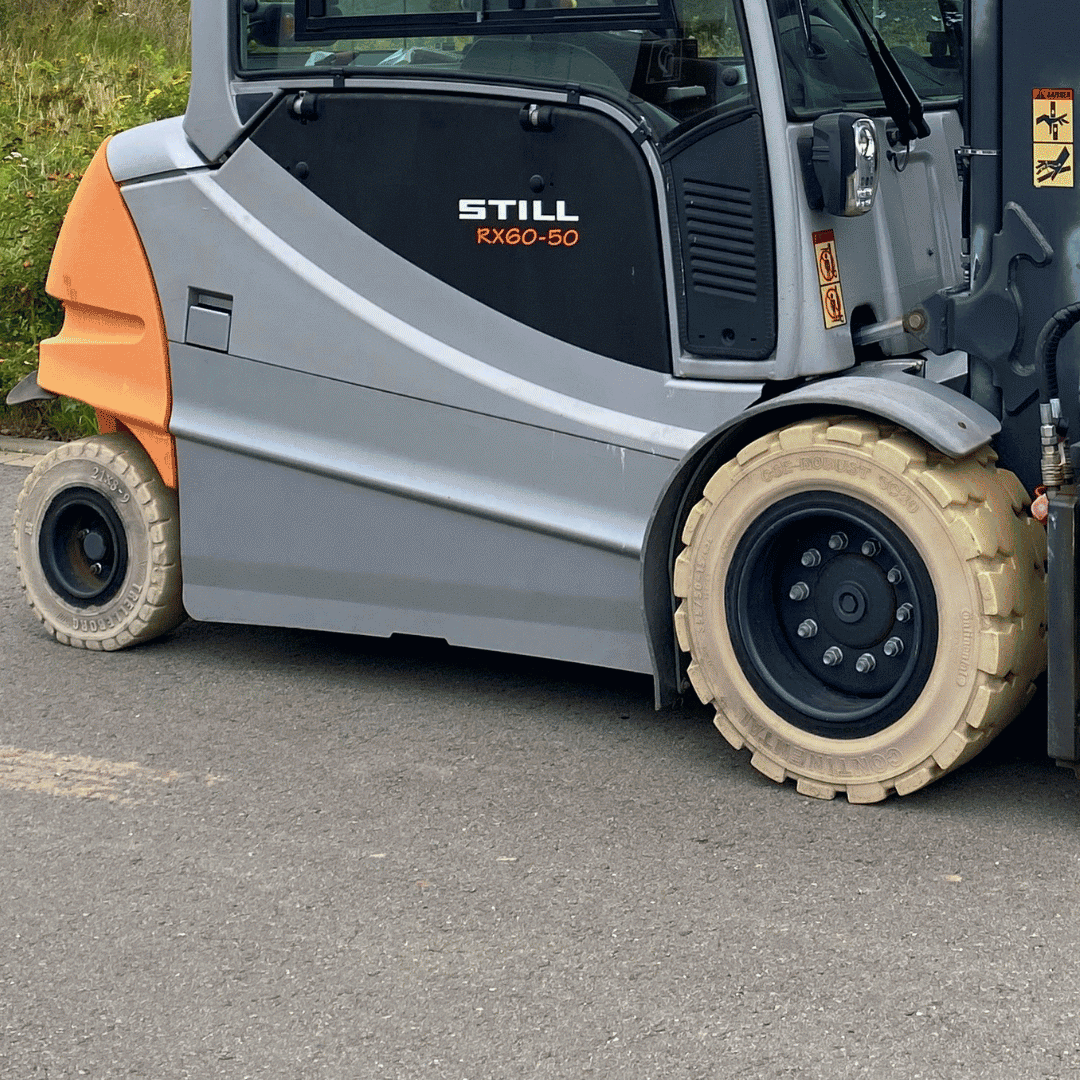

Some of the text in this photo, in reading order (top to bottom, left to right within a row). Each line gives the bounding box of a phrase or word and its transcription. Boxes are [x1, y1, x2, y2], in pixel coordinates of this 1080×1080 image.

[458, 199, 580, 222] STILL
[476, 227, 580, 247] RX60-50
[72, 582, 144, 633] TRELLEBORG
[740, 706, 904, 777] CONTINENTAL
